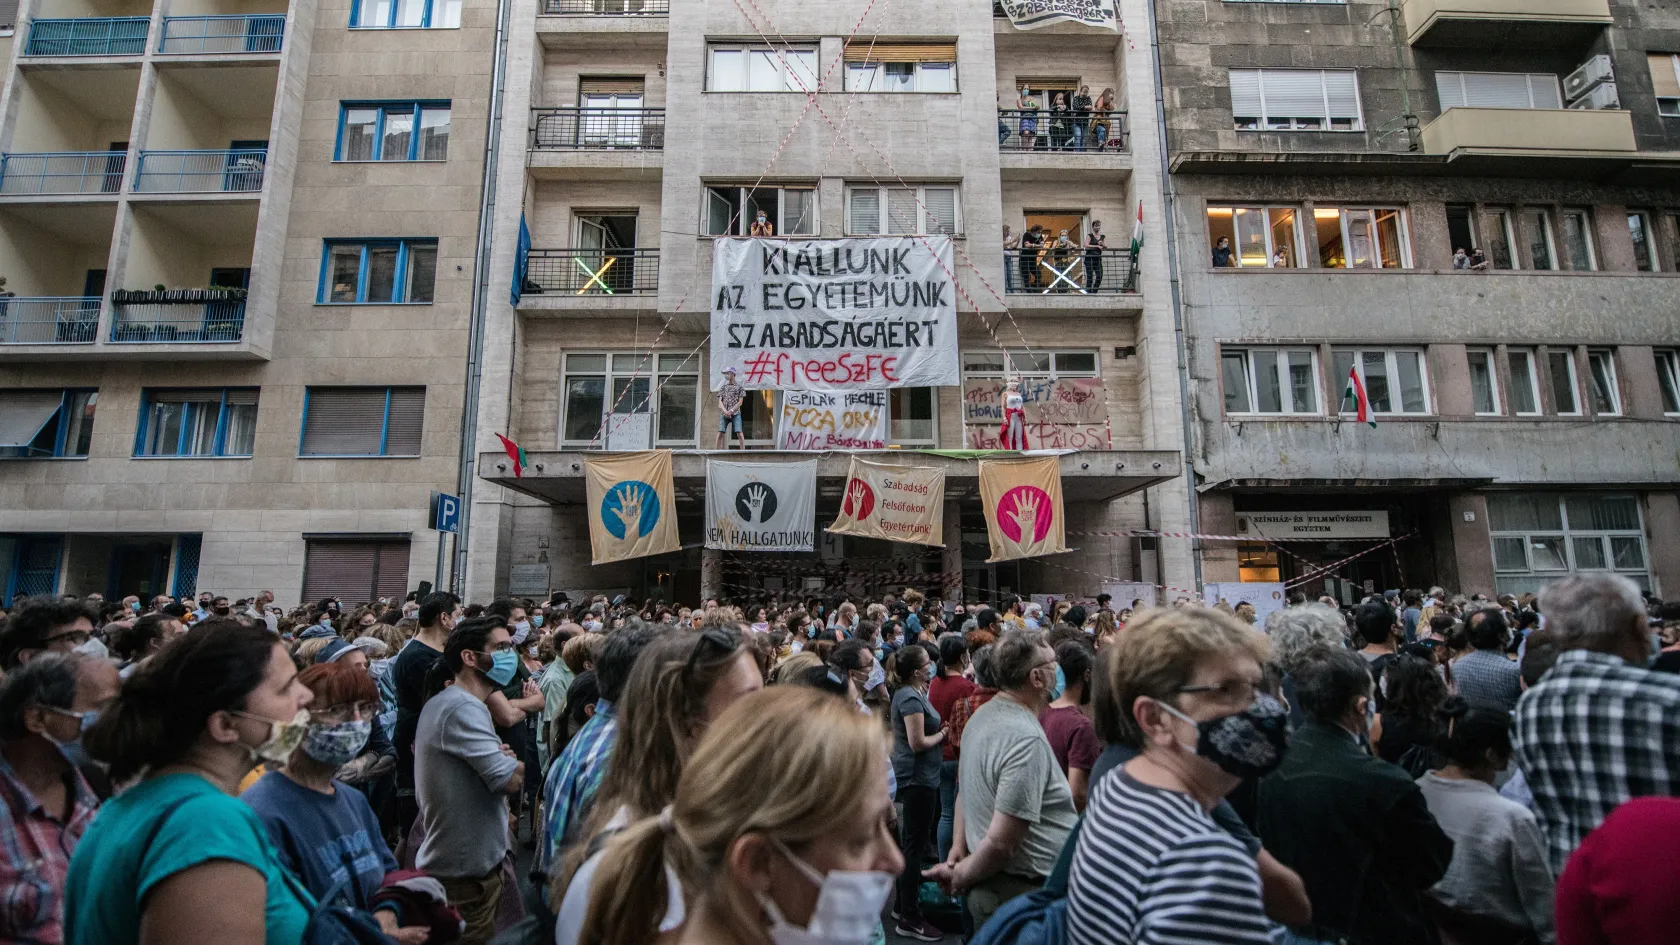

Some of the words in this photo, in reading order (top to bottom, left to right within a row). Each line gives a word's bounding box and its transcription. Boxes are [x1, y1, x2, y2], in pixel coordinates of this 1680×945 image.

[763, 243, 911, 276] KIÁLLUNK
[716, 285, 746, 311] AZ
[763, 277, 948, 310] EGYETEMÜNK
[727, 315, 939, 349] SZABADSÁGÁÉRT
[744, 351, 899, 385] #freeSzFE
[883, 478, 928, 496] Szabadság
[442, 499, 456, 526] P
[881, 498, 926, 514] Felsőfokon
[1293, 514, 1303, 523] ÉS
[731, 529, 814, 547] HALLGATUNK!
